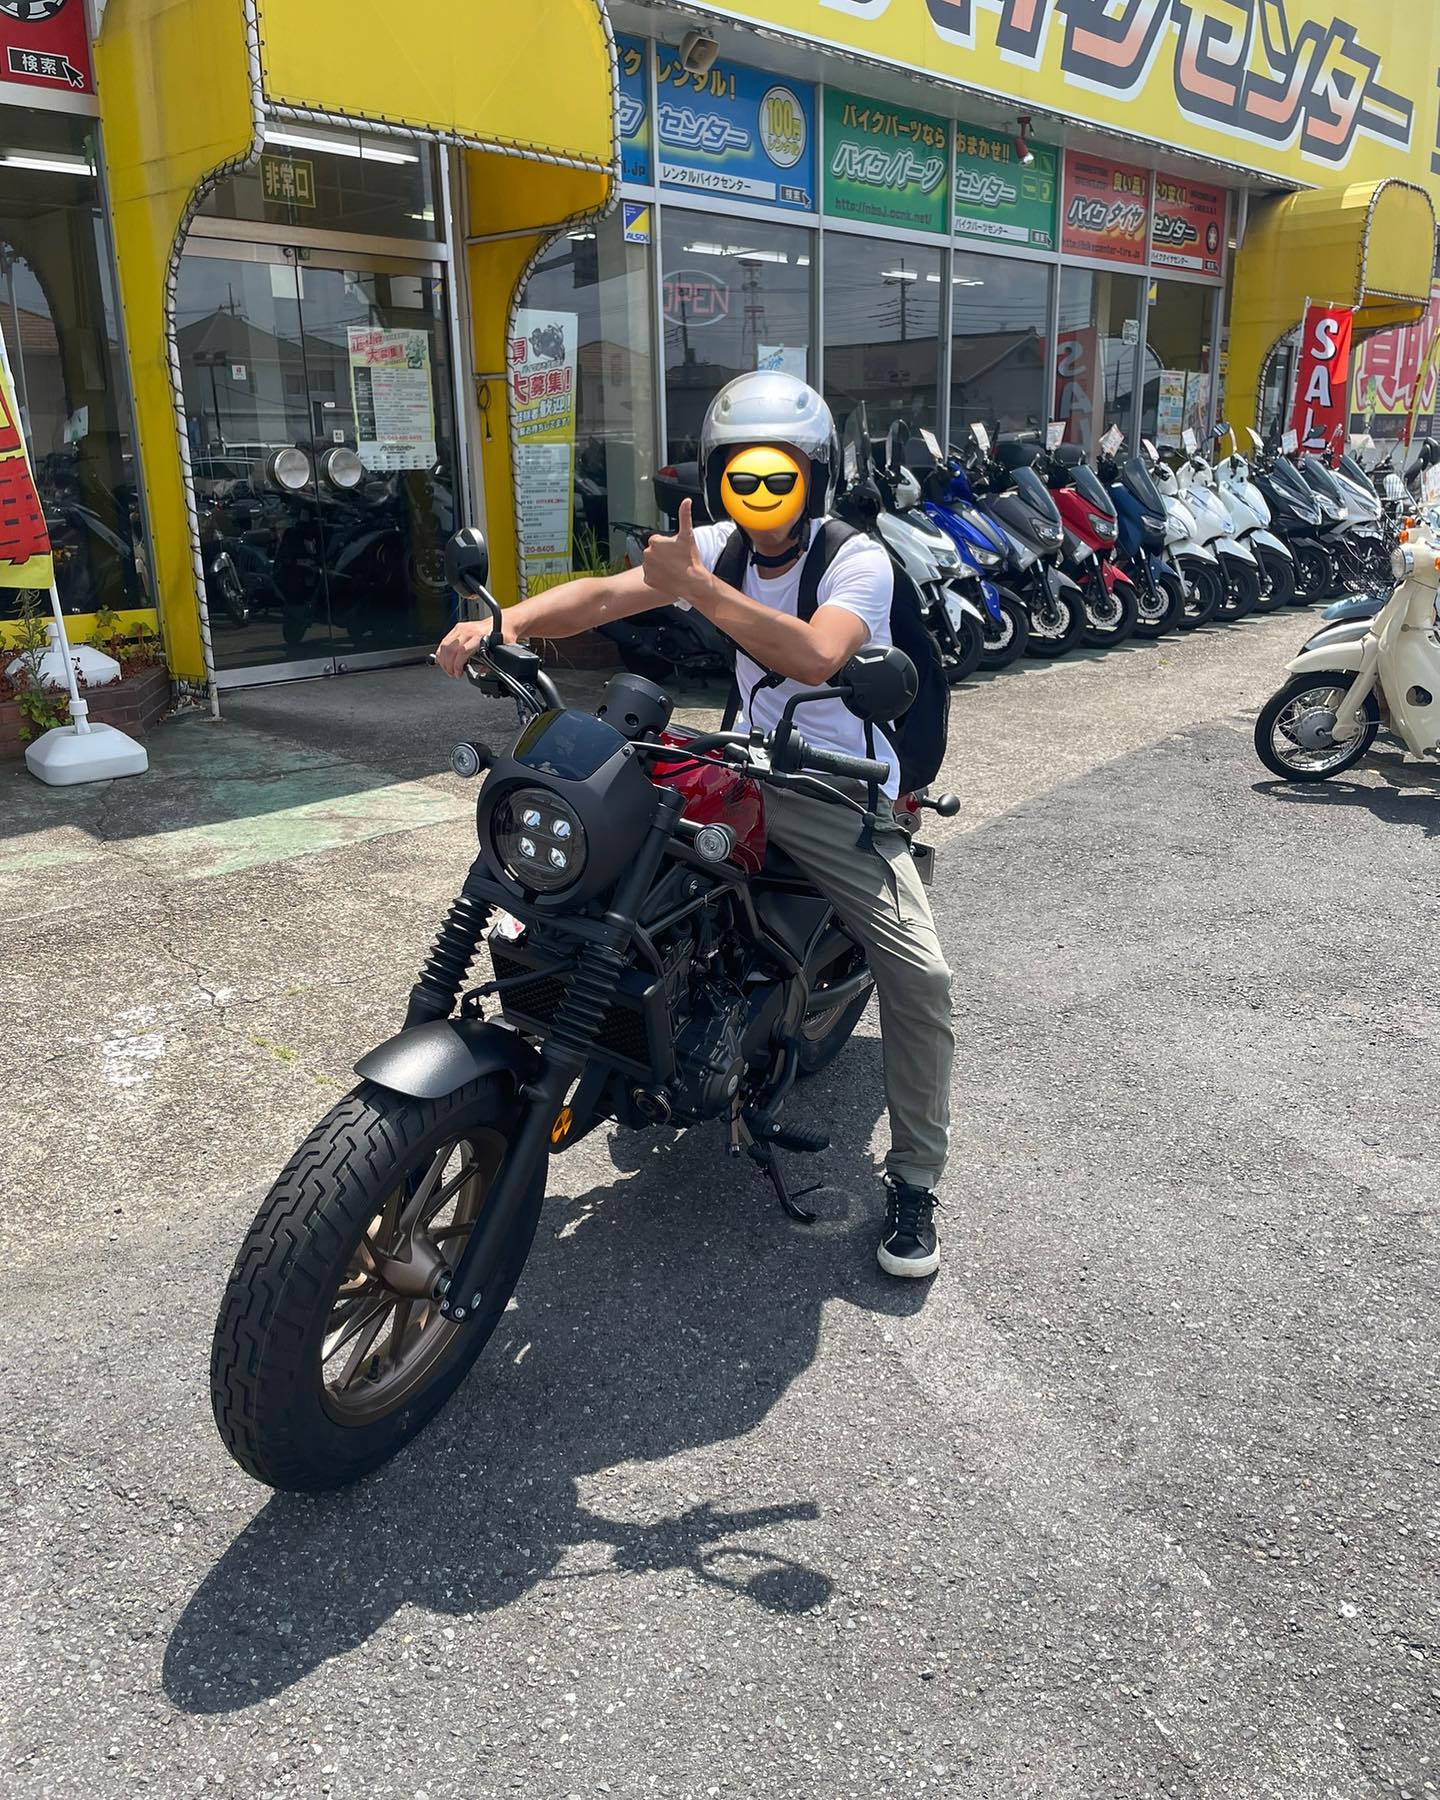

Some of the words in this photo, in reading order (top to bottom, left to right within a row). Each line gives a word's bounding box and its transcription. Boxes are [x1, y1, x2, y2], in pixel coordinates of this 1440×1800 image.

[22, 53, 57, 75] 検索
[657, 102, 752, 154] センター
[767, 97, 801, 140] 100円
[843, 104, 946, 149] バイクパーツなら
[265, 161, 309, 199] 非常口
[662, 165, 752, 192] レンタルバイクセンター
[955, 167, 1017, 208] センター
